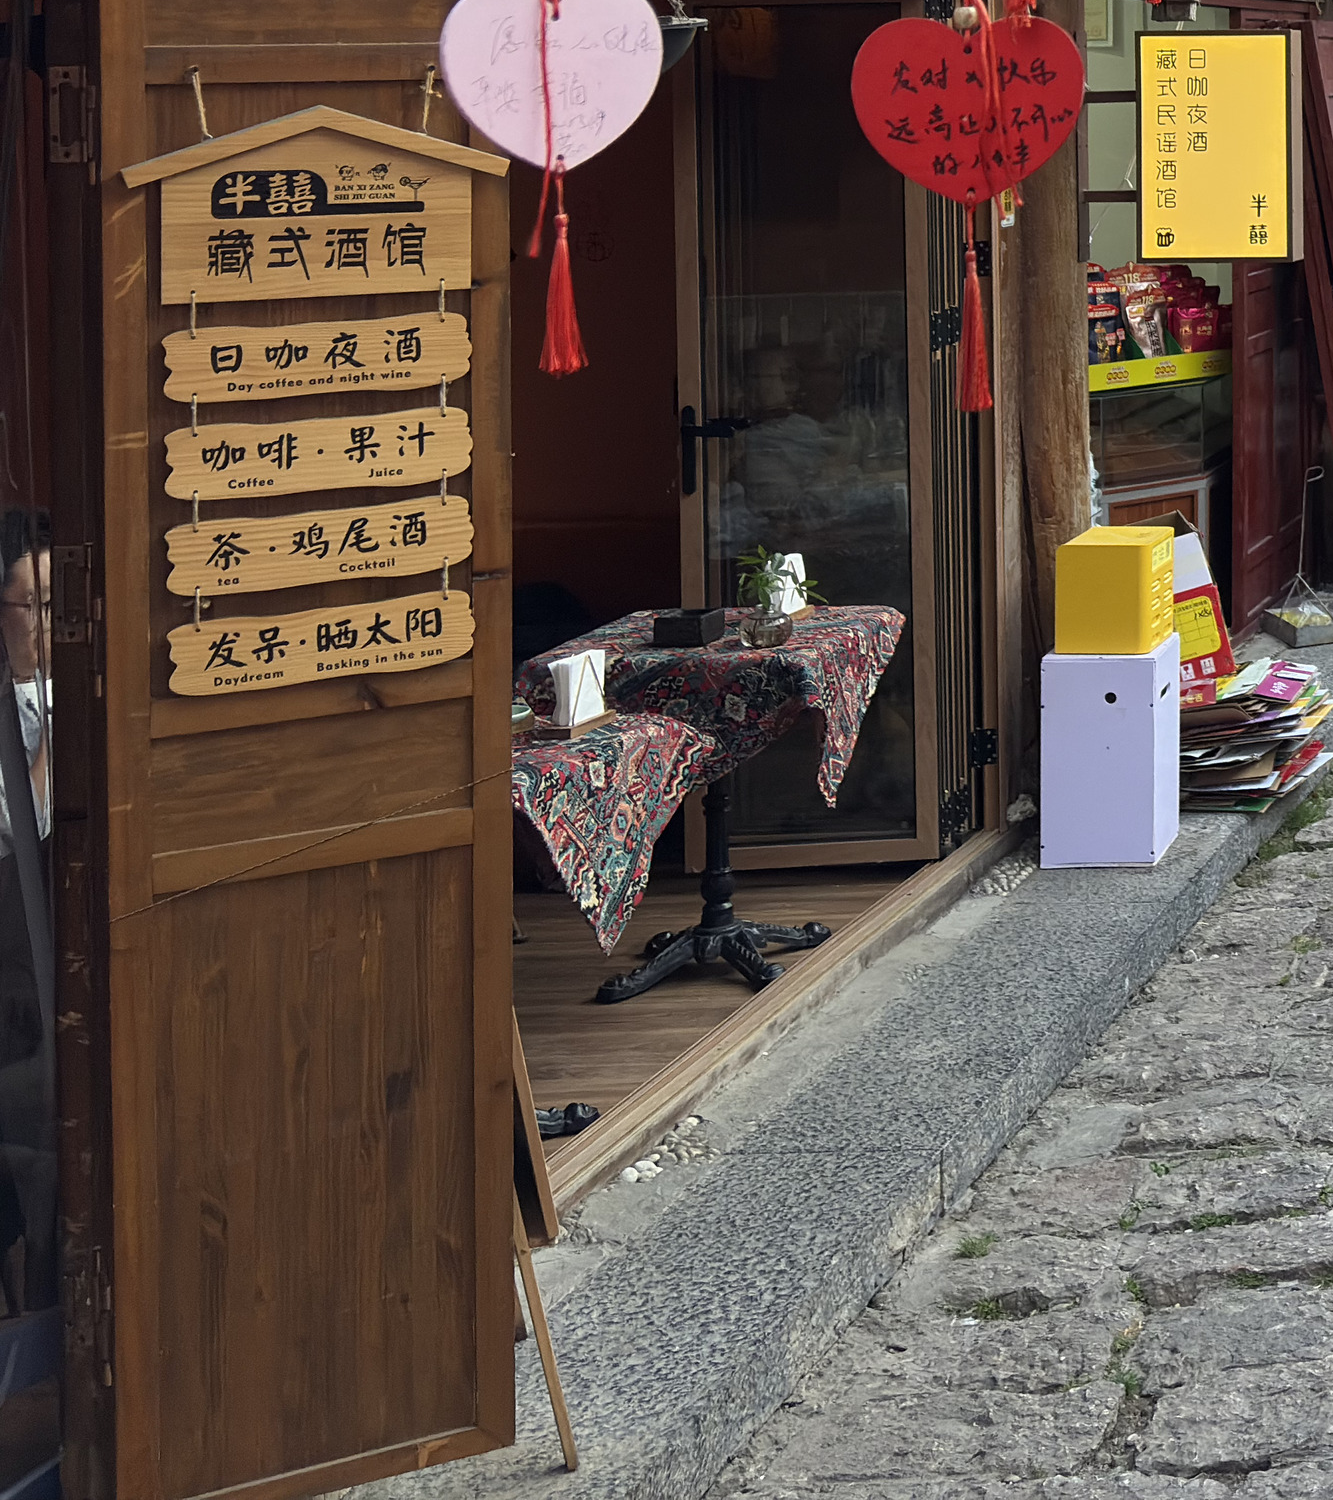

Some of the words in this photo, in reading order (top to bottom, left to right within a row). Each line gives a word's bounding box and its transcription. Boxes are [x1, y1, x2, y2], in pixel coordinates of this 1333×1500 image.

[1186, 48, 1209, 153] 日咖夜酒
[1156, 49, 1178, 210] 藏式民谣酒馆
[334, 184, 354, 192] BAN
[357, 184, 367, 192] XI
[369, 183, 395, 191] ZANG
[334, 193, 349, 201] SHI
[370, 192, 396, 200] GUAN
[207, 222, 427, 283] 藏式酒馆
[210, 327, 422, 374] 日咖夜酒
[227, 381, 254, 393] Day
[259, 376, 303, 390] coffee
[309, 374, 334, 385] and
[340, 371, 375, 384] night
[381, 369, 412, 379] wine
[228, 478, 275, 490] Coffee
[368, 466, 404, 478] Juice
[217, 576, 240, 586] tea
[339, 558, 396, 573] Cocktail
[214, 669, 284, 687] Daydream
[316, 658, 370, 672] Basking
[375, 654, 388, 665] in
[394, 651, 415, 662] the
[420, 648, 443, 658] sun
